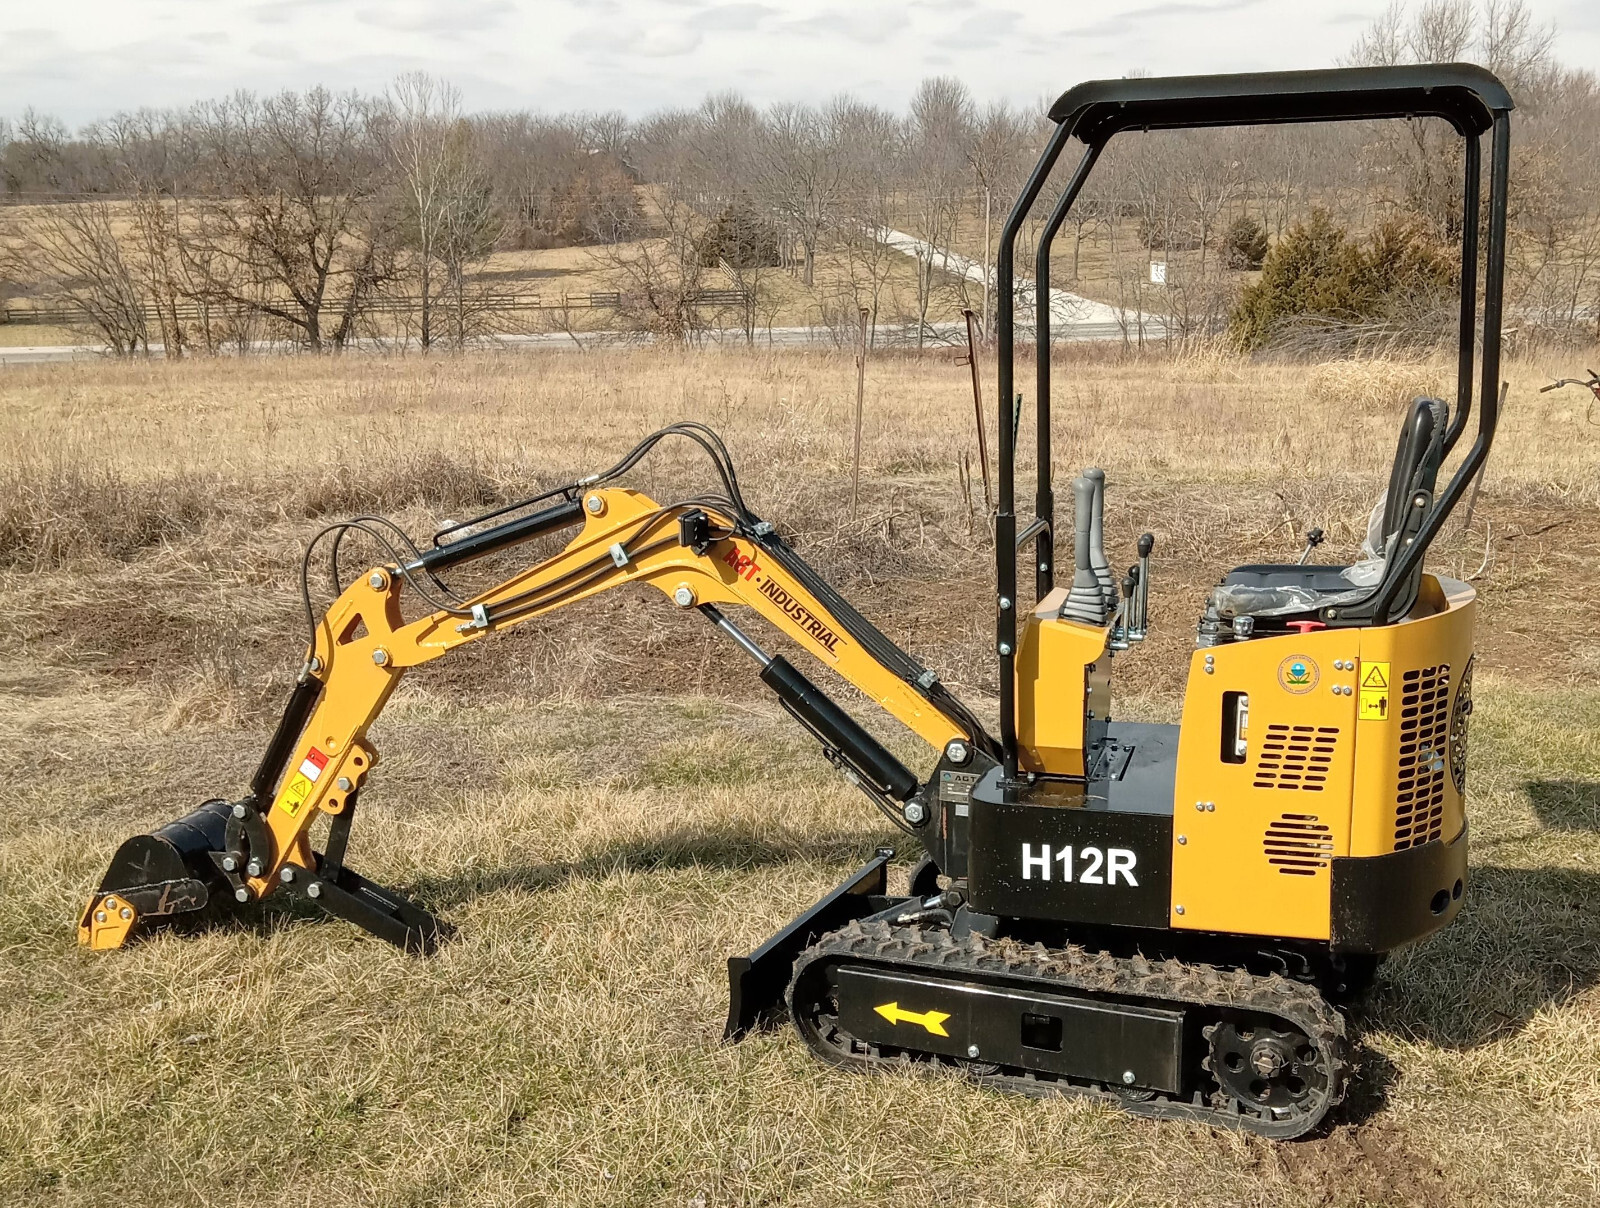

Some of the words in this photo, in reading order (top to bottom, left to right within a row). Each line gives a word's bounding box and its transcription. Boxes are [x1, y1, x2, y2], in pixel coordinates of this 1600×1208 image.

[759, 579, 839, 652] INDUSTRIAL
[955, 775, 977, 783] AGT
[1022, 843, 1139, 887] H12R
